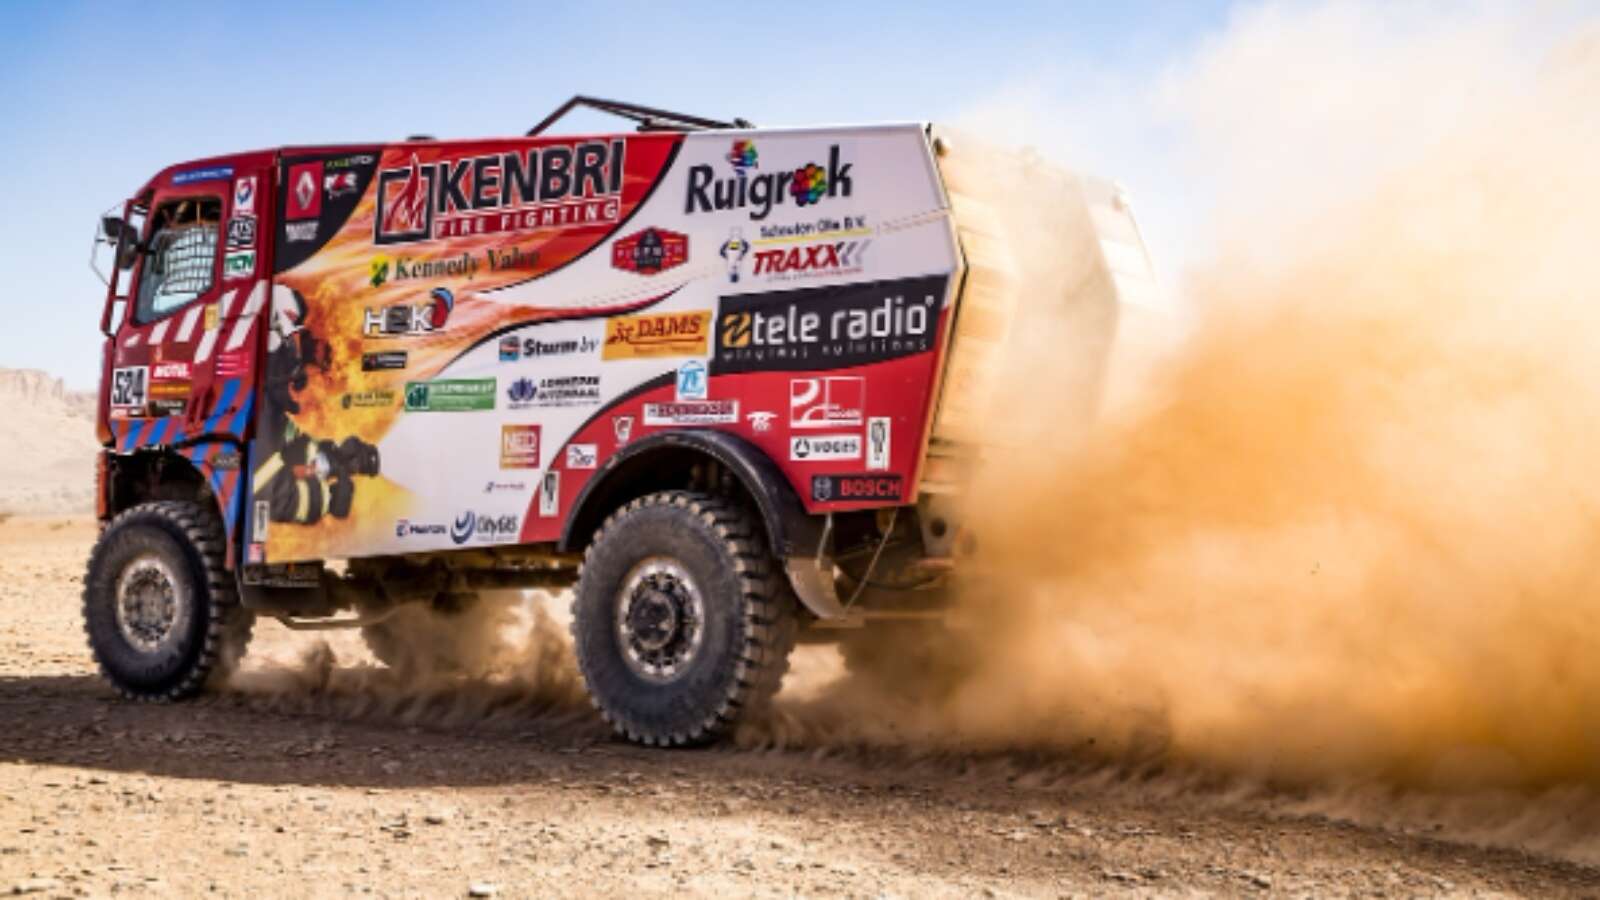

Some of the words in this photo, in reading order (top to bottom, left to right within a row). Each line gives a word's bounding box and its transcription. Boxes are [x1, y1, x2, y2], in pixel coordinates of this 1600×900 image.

[437, 138, 626, 214] KENBRI
[437, 215, 486, 237] FIRE
[500, 203, 618, 228] FIGHTING
[395, 251, 480, 280] Kennedy
[486, 247, 540, 271] Valve
[753, 243, 844, 276] TRAXX
[637, 314, 703, 338] DAMS
[752, 304, 820, 345] tele
[830, 294, 928, 341] radio
[112, 368, 145, 405] 524
[840, 477, 902, 497] BOSCH
